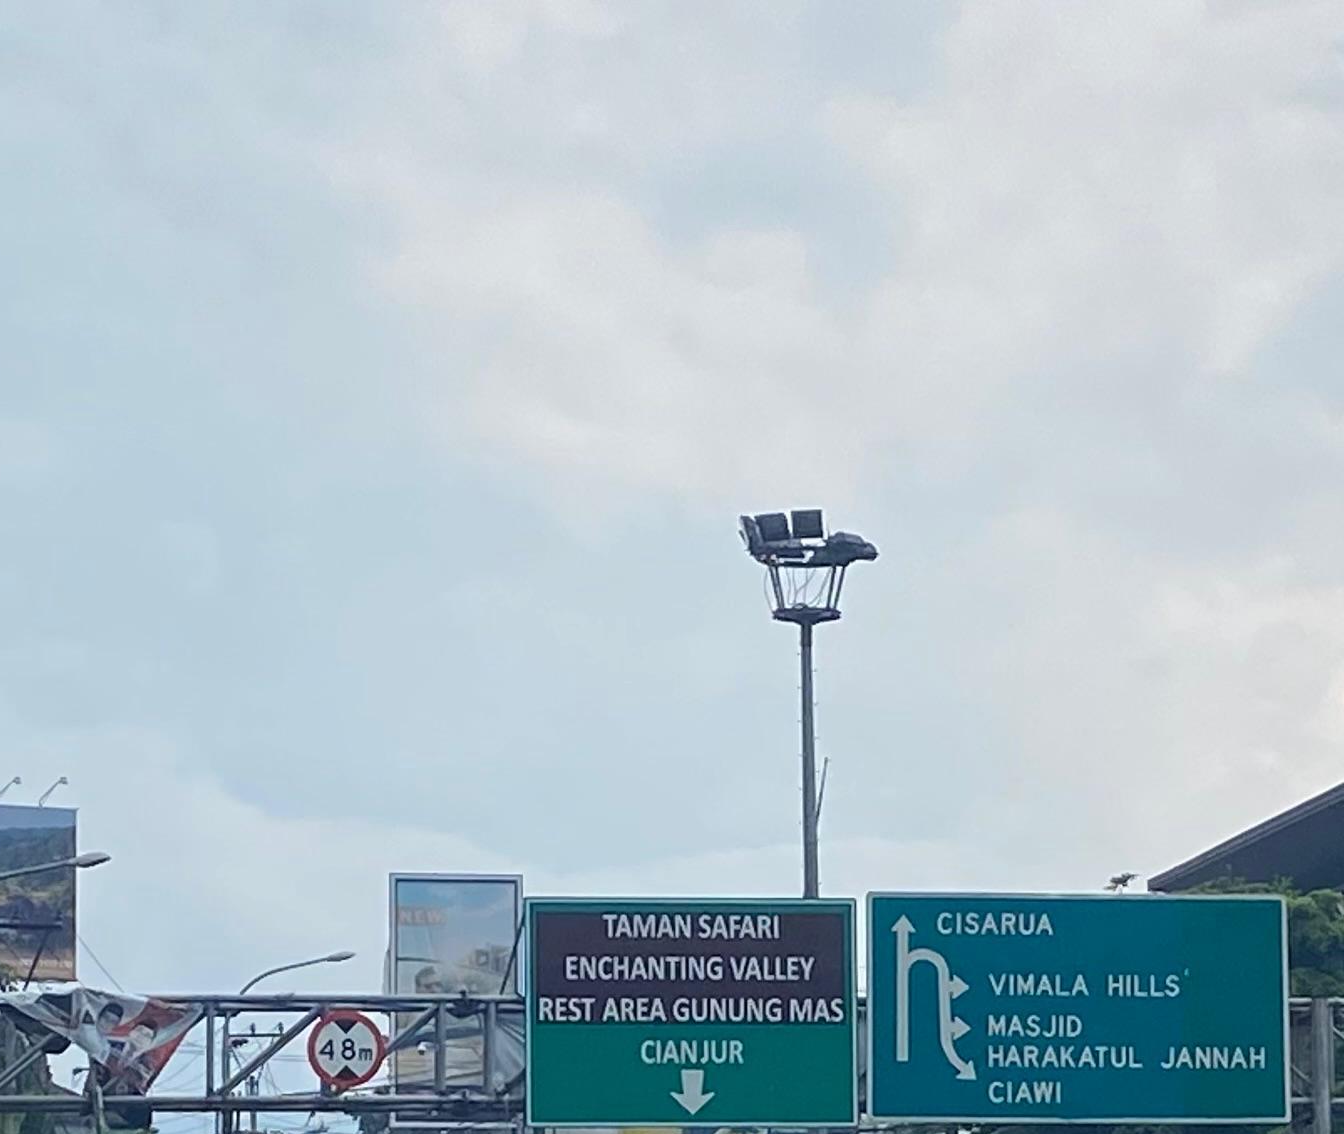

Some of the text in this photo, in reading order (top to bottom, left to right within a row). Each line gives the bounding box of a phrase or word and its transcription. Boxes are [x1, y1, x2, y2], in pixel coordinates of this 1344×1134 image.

[603, 914, 781, 939] TAMAN SAFARI
[936, 912, 1054, 936] CISARUA
[565, 956, 815, 981] ENCHANTING VALLEY
[988, 973, 1181, 997] VIMALA HILLS
[538, 997, 844, 1022] REST AREA GUNUNG MAS
[987, 1015, 1083, 1038] MASJID
[640, 1040, 744, 1064] CIANJUR
[987, 1045, 1266, 1070] HARAKATUL JANNAH
[988, 1082, 1062, 1104] CIAWI
